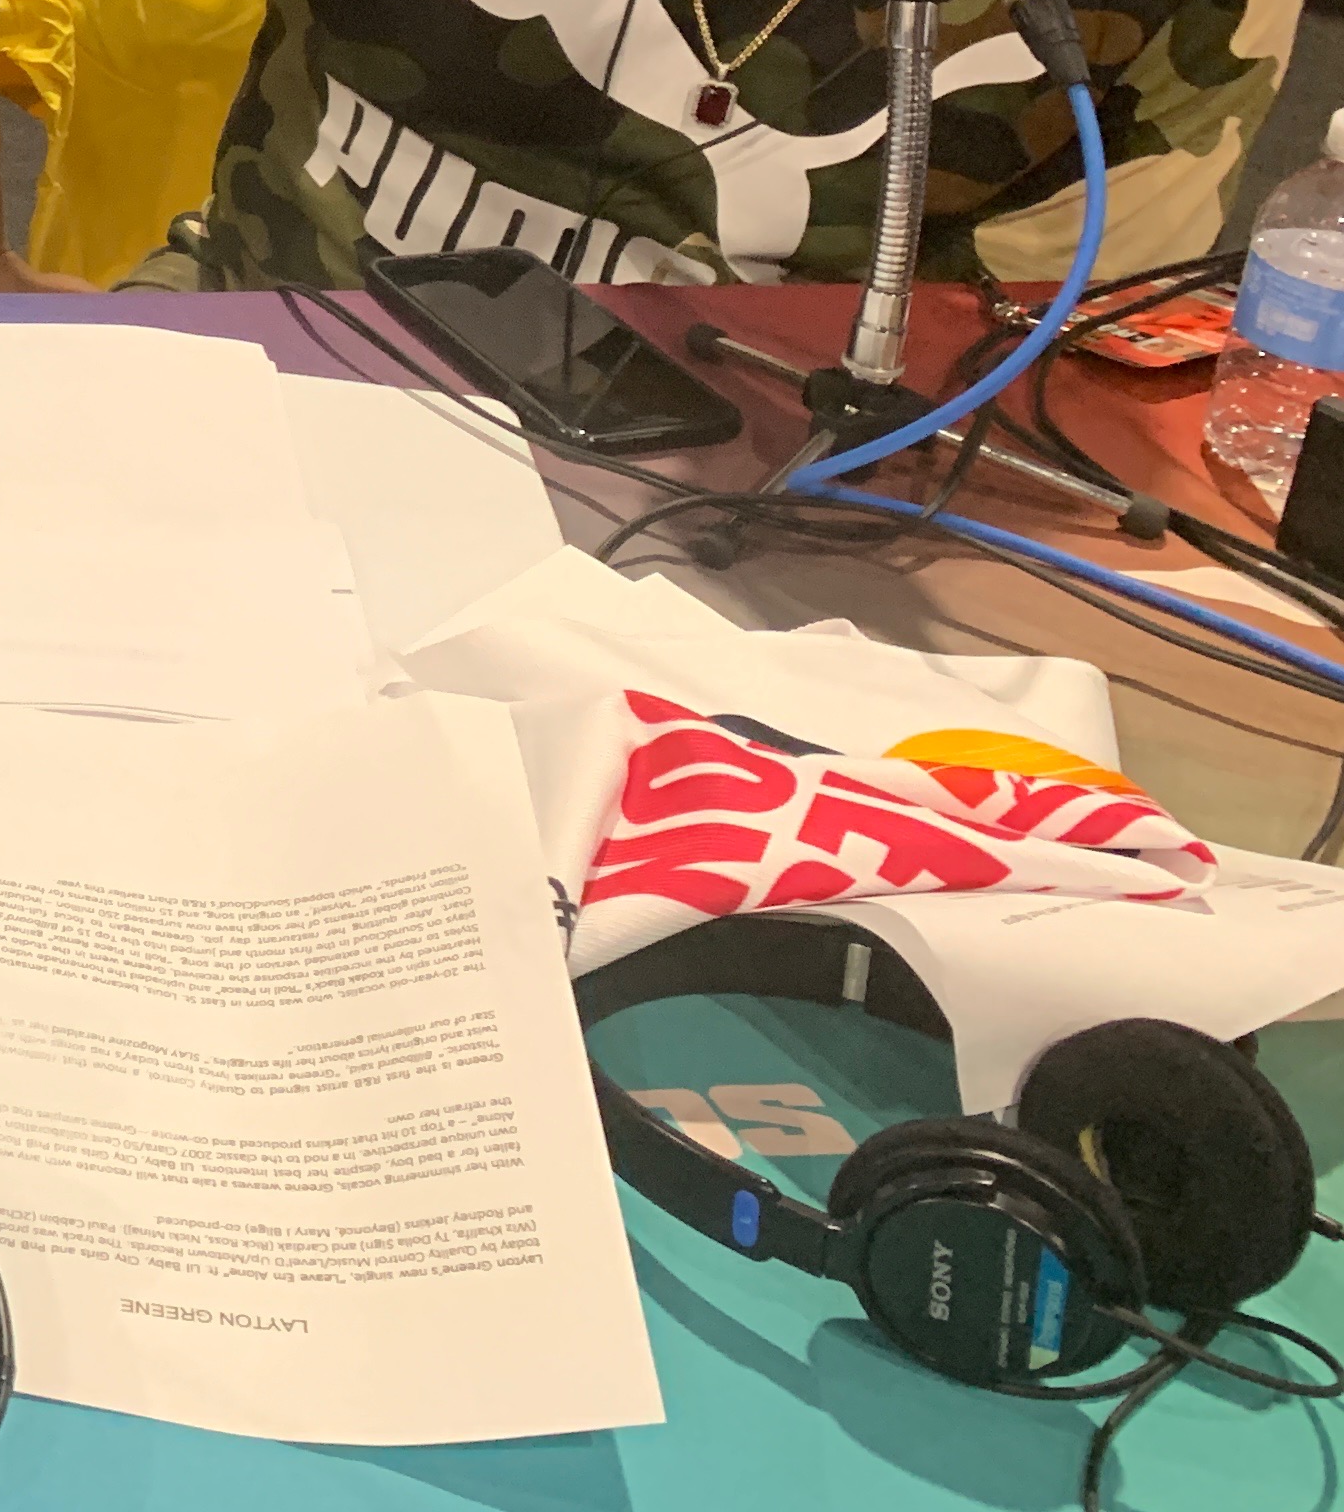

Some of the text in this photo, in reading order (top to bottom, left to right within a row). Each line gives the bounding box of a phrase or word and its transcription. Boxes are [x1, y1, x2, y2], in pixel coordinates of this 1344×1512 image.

[465, 1163, 489, 1174] her
[491, 1159, 525, 1170] With
[385, 1165, 462, 1187] shimmering
[192, 1178, 218, 1188] tale
[453, 1207, 505, 1223] Rodney
[507, 1206, 534, 1216] and
[88, 1222, 117, 1234] Paul
[404, 1216, 450, 1230] Jerkins
[506, 1221, 537, 1234] (Wiz
[32, 1228, 59, 1238] was
[245, 1224, 283, 1236] Blige)
[453, 1224, 503, 1240] Khalifa,
[62, 1232, 95, 1245] track
[169, 1233, 202, 1244] Nicki
[205, 1235, 239, 1248] Ross,
[397, 1236, 432, 1247] Dolla
[434, 1231, 449, 1243] Ty
[501, 1236, 541, 1250] today
[20, 1241, 46, 1252] PnB
[98, 1238, 123, 1249] The
[242, 1239, 275, 1250] (Rick
[480, 1241, 498, 1253] by
[51, 1245, 77, 1256] and
[80, 1250, 110, 1261] Girls
[428, 1244, 478, 1260] Quality
[115, 1252, 141, 1265] City
[146, 1256, 182, 1271] Baby,
[375, 1253, 426, 1265] Control
[497, 1254, 544, 1269] Layton
[223, 1269, 269, 1280] Alone"
[431, 1263, 493, 1277] Greene's
[929, 1239, 954, 1321] SONY
[121, 1301, 309, 1336] LAYTON GREENE
